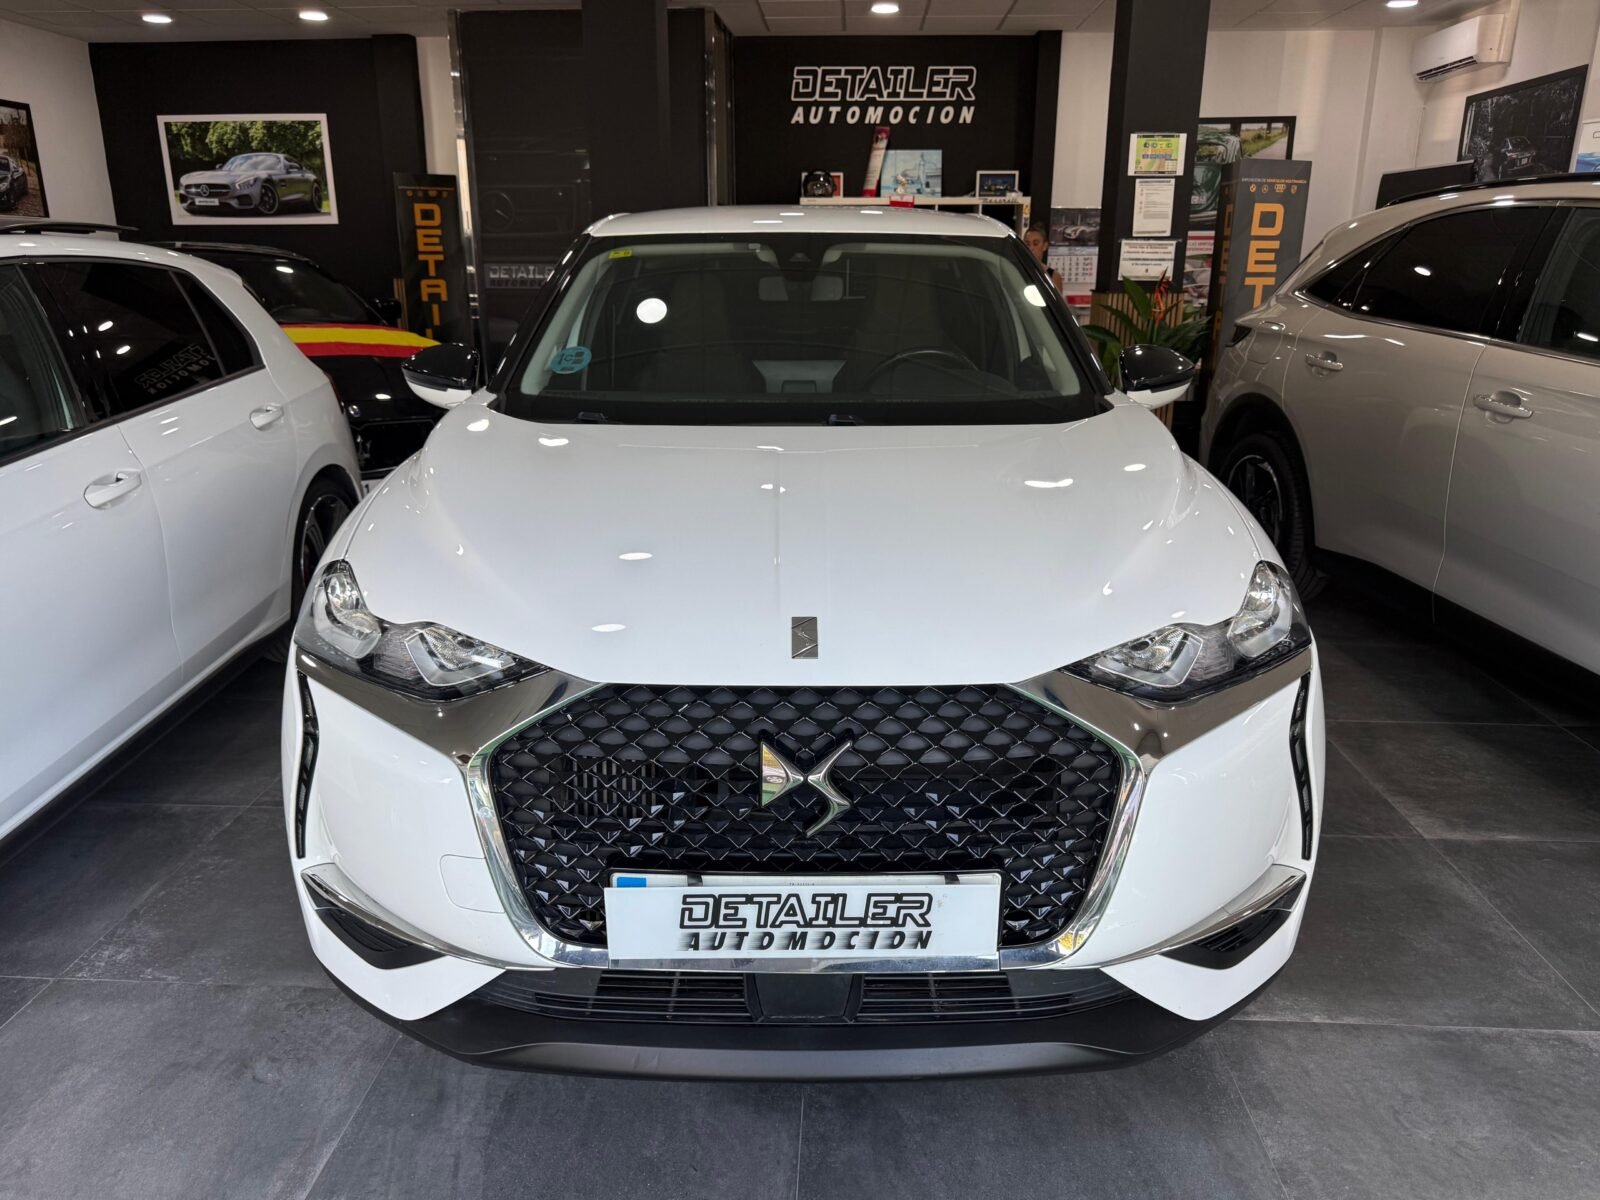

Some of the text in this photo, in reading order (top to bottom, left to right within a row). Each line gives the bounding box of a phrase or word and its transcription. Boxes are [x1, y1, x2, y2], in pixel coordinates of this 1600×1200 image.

[790, 65, 977, 102] DETAILER
[790, 105, 976, 125] AUTOMOCION
[679, 893, 933, 929] DETAILER
[680, 930, 933, 952] AUTOMOCION
